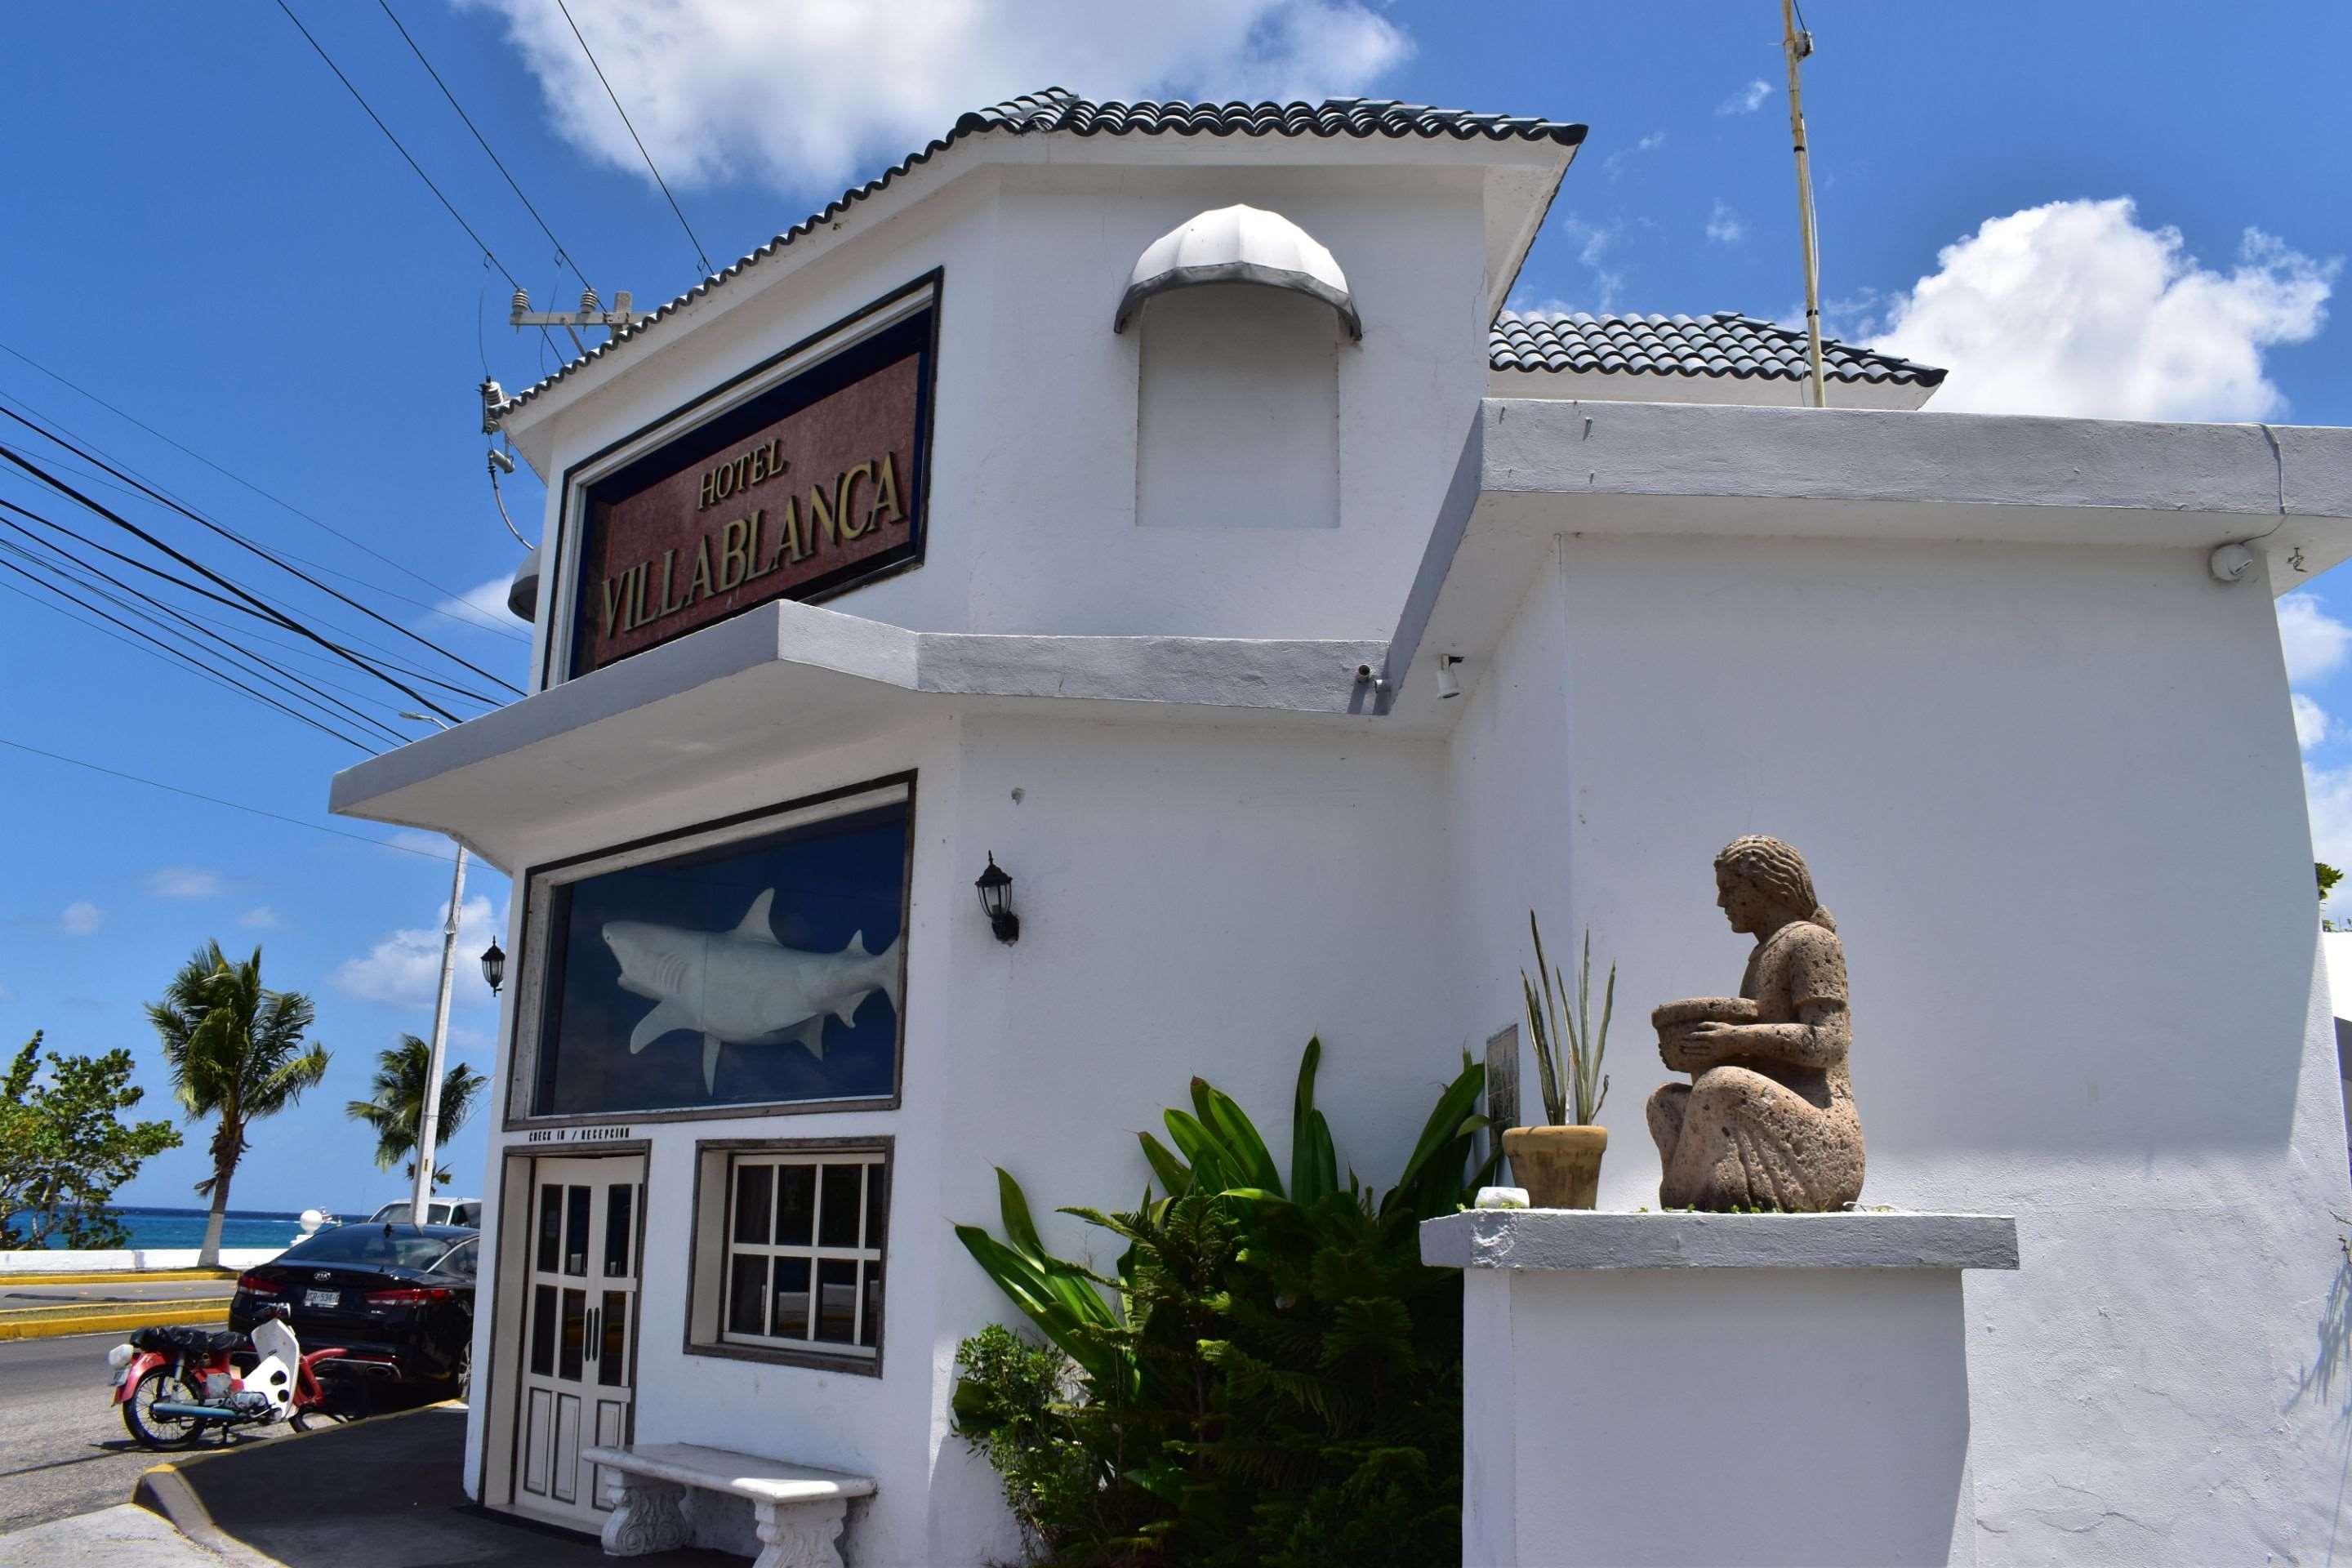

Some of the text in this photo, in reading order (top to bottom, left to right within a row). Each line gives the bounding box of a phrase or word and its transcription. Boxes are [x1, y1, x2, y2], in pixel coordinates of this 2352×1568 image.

[698, 439, 788, 511] HOTEL
[602, 452, 906, 639] VILLABLANCA
[529, 1127, 630, 1142] CHECK IN / RECEPCION
